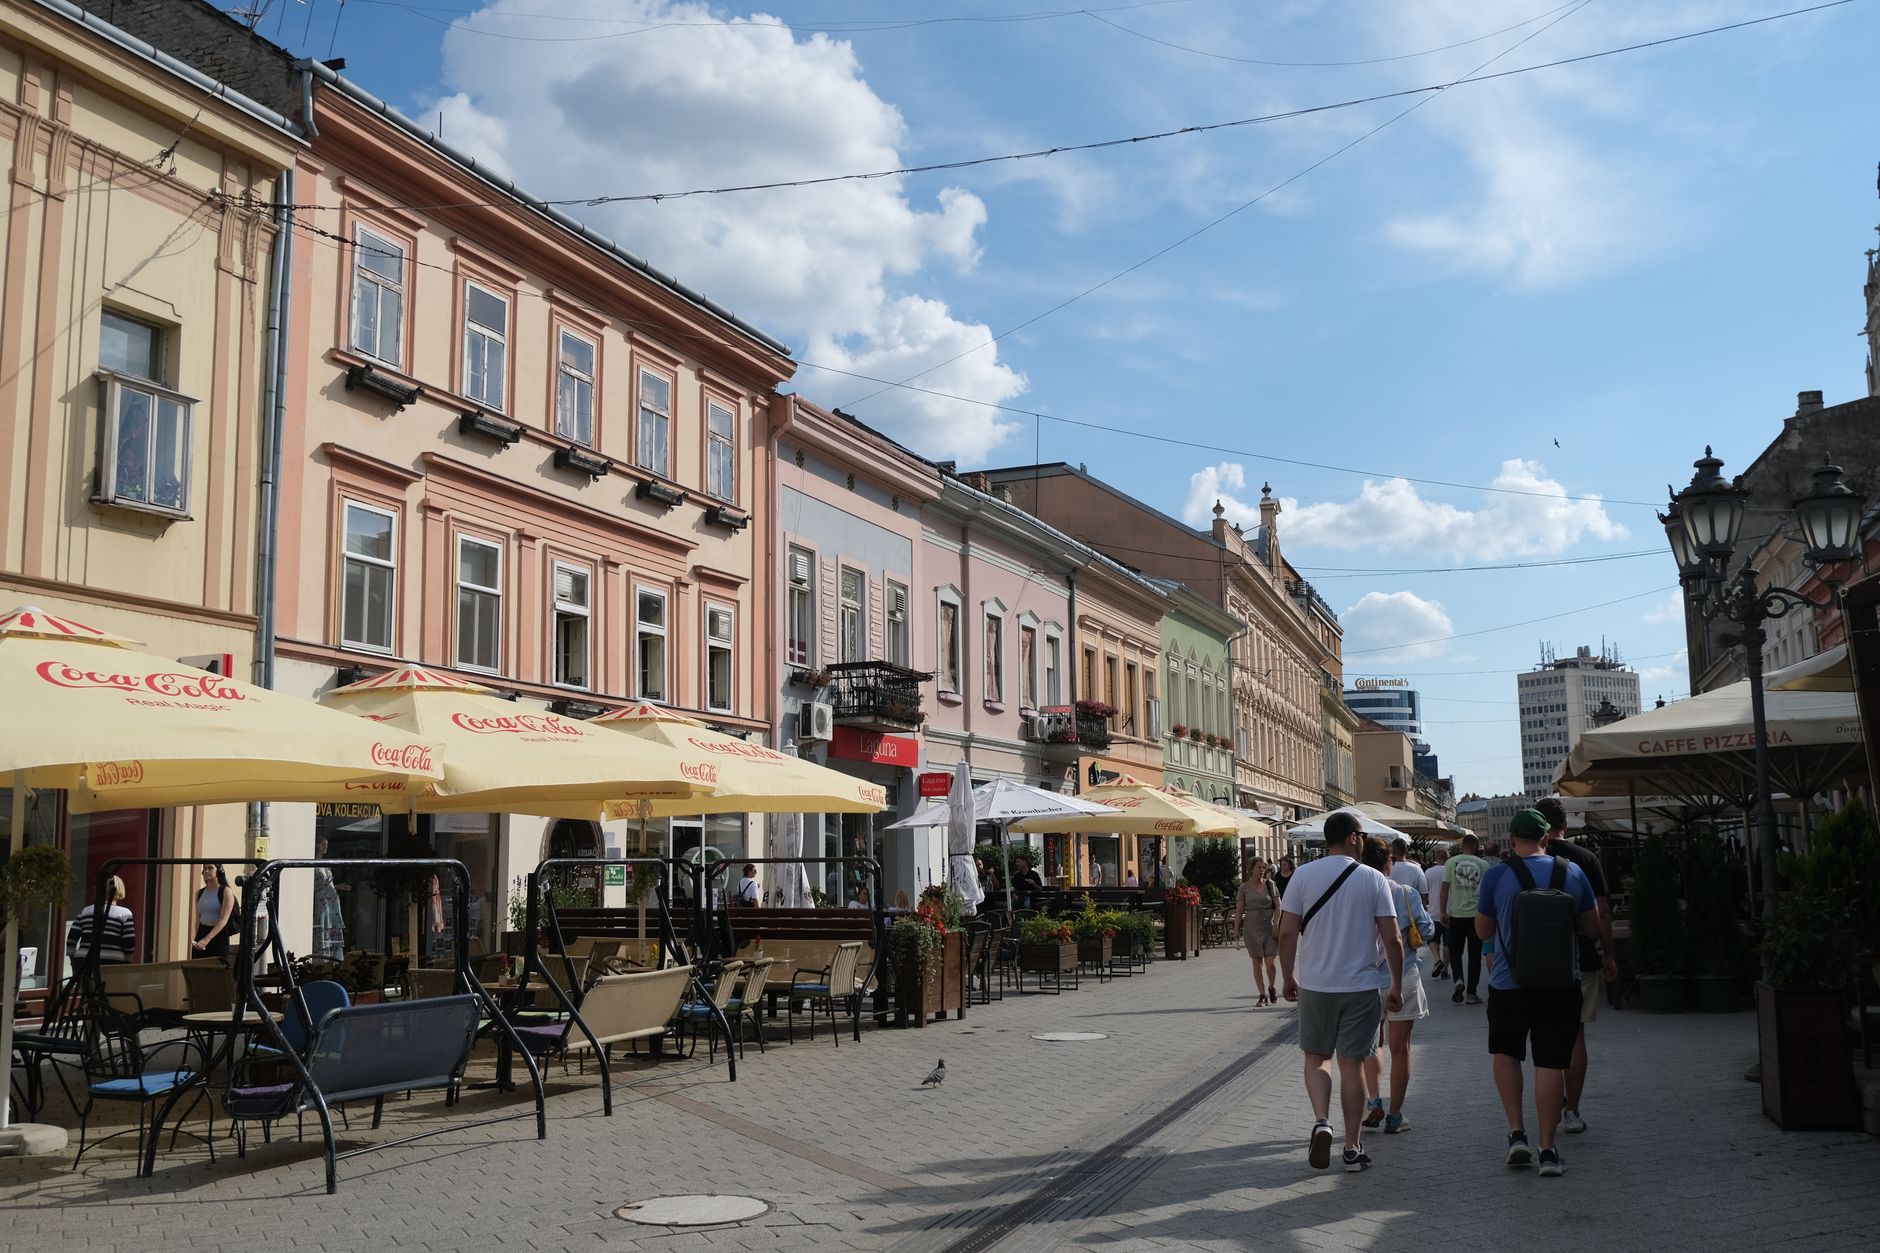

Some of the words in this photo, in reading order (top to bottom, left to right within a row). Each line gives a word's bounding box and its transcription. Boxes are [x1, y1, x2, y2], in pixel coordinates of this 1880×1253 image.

[36, 661, 246, 700] Coca-Cola
[124, 698, 175, 709] Real
[175, 701, 232, 712] Magic
[451, 712, 584, 736] Coca-Cola
[860, 736, 897, 759] Laguna
[1638, 737, 1697, 754] CAFFE
[371, 742, 432, 771] Coca-Cola
[680, 761, 717, 783] Coca-Cola
[335, 804, 381, 819] KOLEKCIJA
[1011, 807, 1063, 815] Krombacher
[1155, 820, 1185, 831] Coca-Cola
